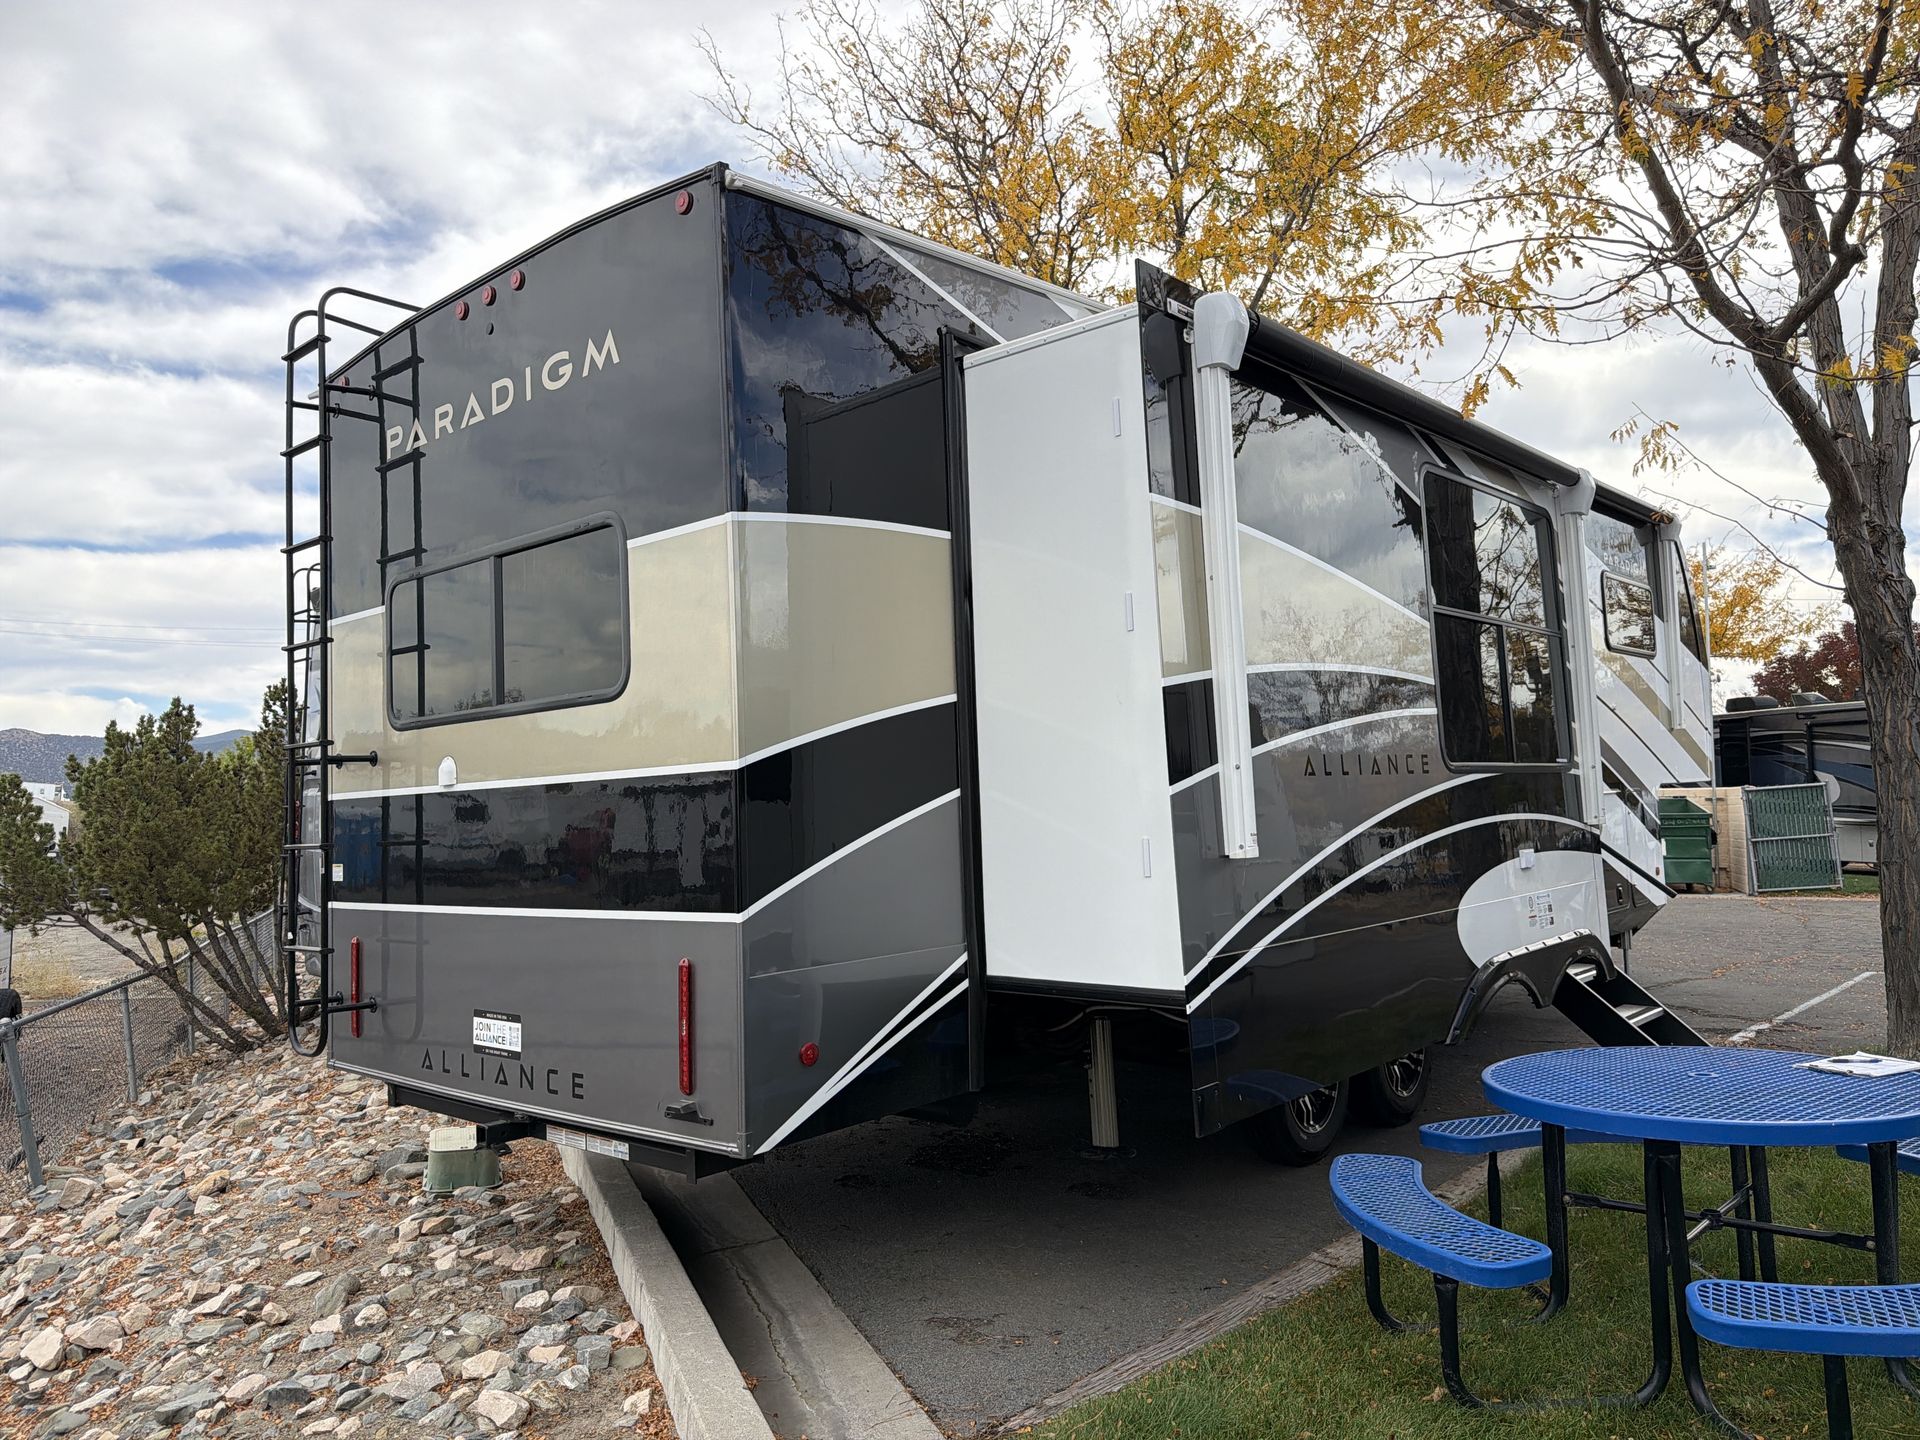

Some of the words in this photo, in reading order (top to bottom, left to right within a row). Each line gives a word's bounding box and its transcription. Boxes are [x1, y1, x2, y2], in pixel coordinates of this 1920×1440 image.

[386, 328, 620, 460] PARADIGM
[1304, 754, 1430, 776] ALLIANCE
[475, 1021, 491, 1032] JOIN
[492, 1023, 506, 1035] THE
[475, 1032, 506, 1046] ALLIANCE
[421, 1048, 584, 1100] ALLIANCE
